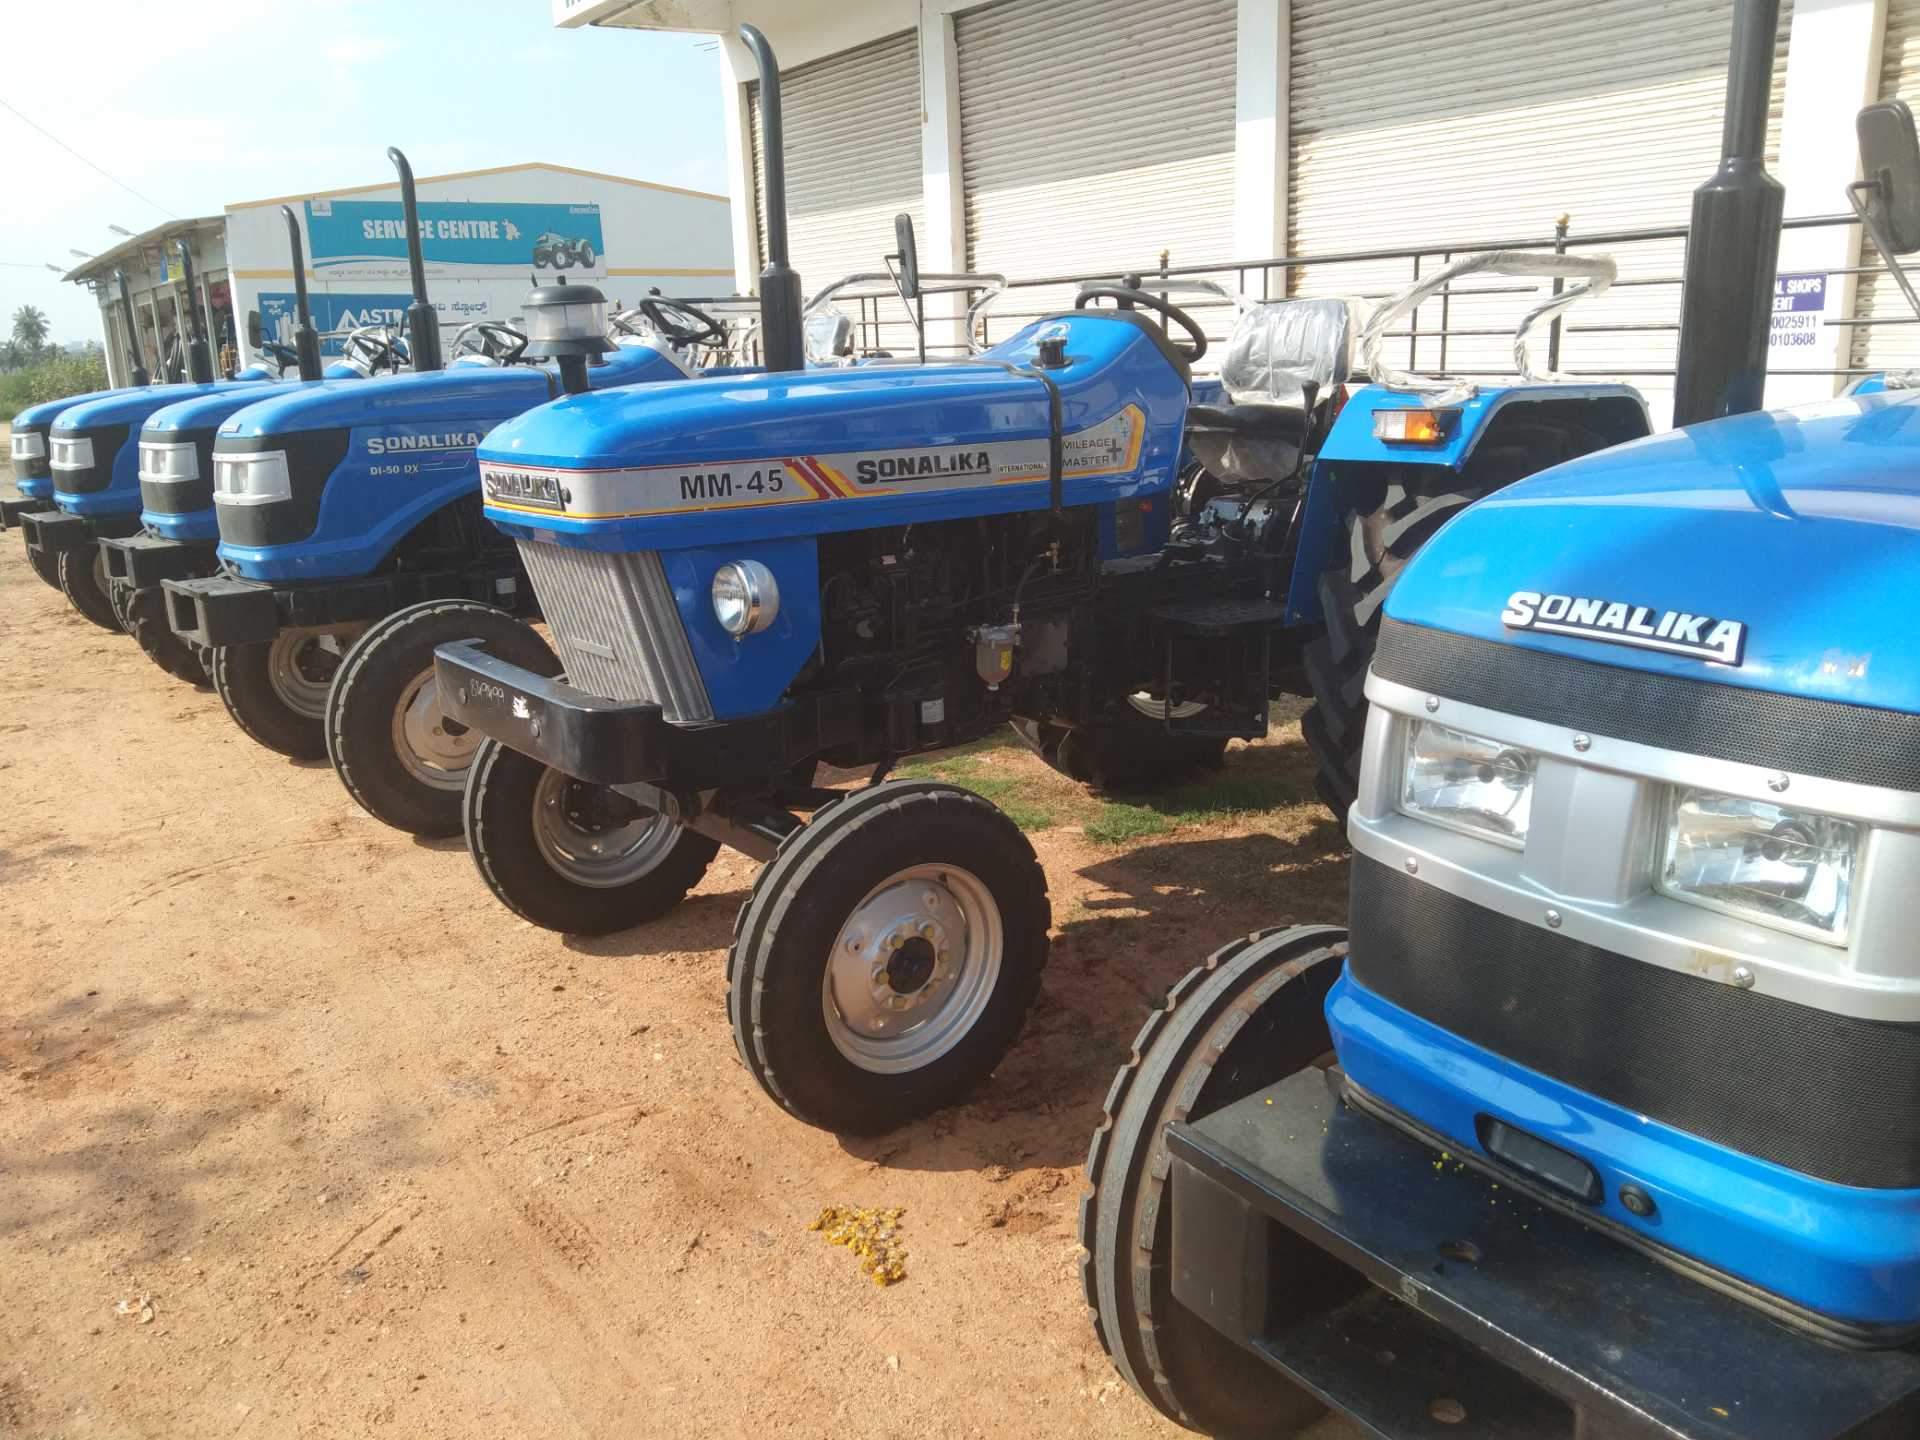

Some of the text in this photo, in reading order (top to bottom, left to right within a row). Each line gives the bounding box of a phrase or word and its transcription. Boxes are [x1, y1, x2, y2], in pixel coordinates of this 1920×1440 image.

[362, 219, 499, 240] SERVCE CENTRE
[1786, 278, 1822, 294] SHOPS
[367, 432, 480, 455] SONALIKA
[1063, 438, 1111, 449] MILEAGE
[370, 463, 419, 475] DI-50 DX
[856, 451, 992, 485] SONALIKA
[1062, 455, 1110, 467] MASTER
[680, 469, 783, 500] MM-45
[1501, 590, 1744, 665] SONALIKA
